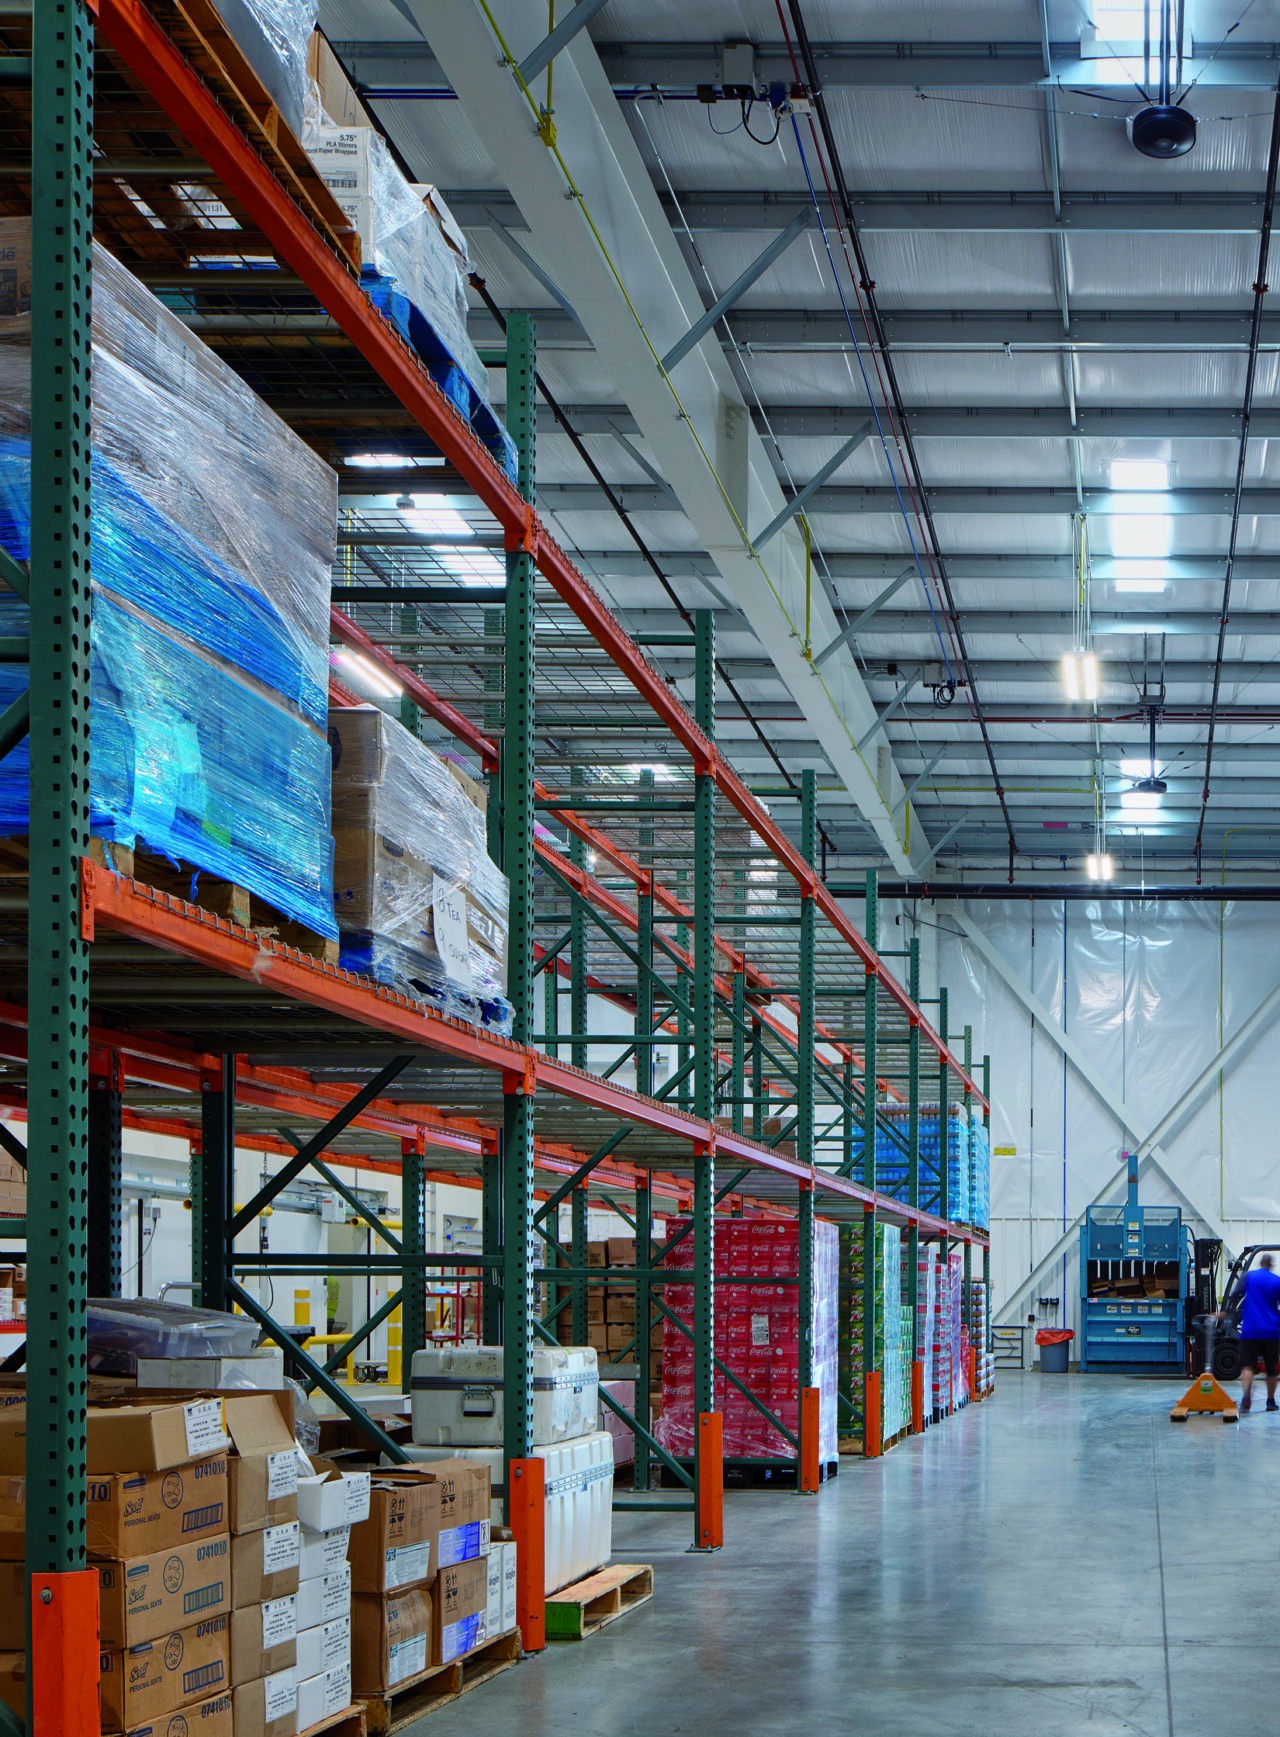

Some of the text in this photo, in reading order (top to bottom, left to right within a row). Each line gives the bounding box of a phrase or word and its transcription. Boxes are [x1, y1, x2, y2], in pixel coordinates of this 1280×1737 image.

[446, 902, 461, 923] TEA
[665, 1365, 692, 1375] Coca-Cola
[664, 1385, 692, 1395] Coca-Cola
[89, 1484, 108, 1500] 10
[124, 1514, 161, 1527] PERSONAL SEATS
[128, 1604, 149, 1615] PERSONAL
[130, 1683, 150, 1693] PERSONAL
